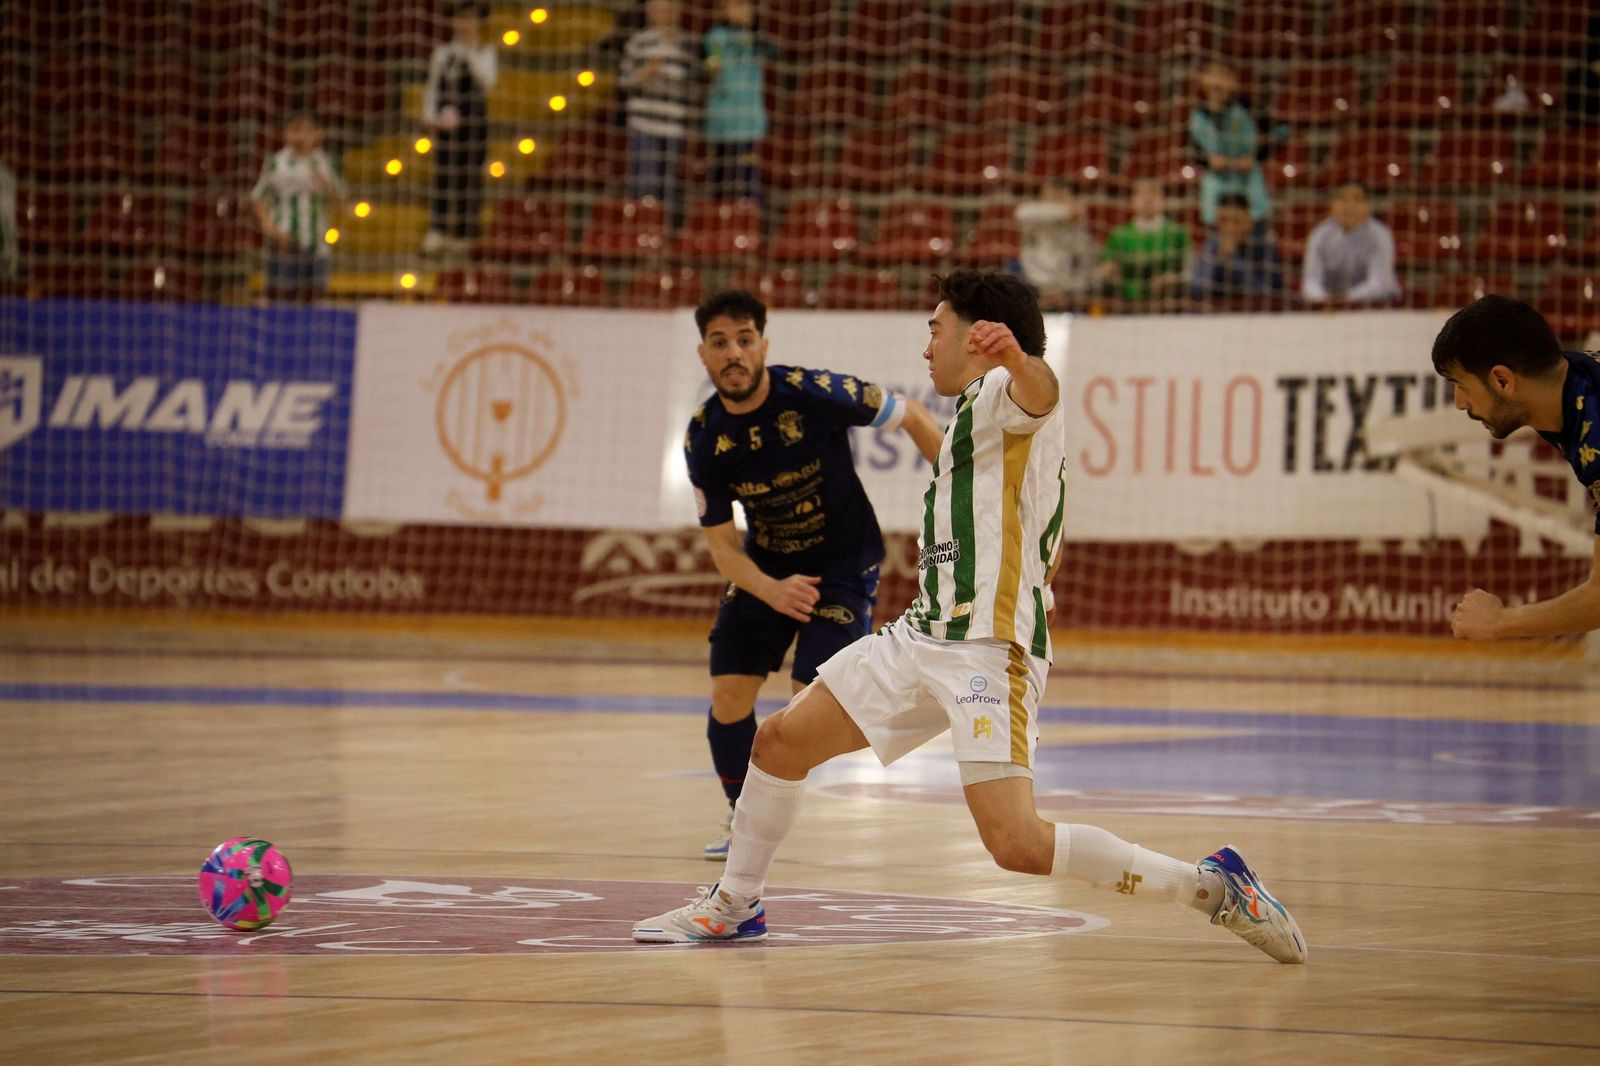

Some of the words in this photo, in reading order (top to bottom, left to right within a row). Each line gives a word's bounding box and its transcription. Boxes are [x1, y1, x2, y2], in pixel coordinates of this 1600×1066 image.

[49, 374, 336, 440] IMANE
[1080, 374, 1263, 478] STILO
[749, 425, 762, 450] 5
[1169, 580, 1331, 622] Instituto
[955, 693, 1001, 706] LeoProex
